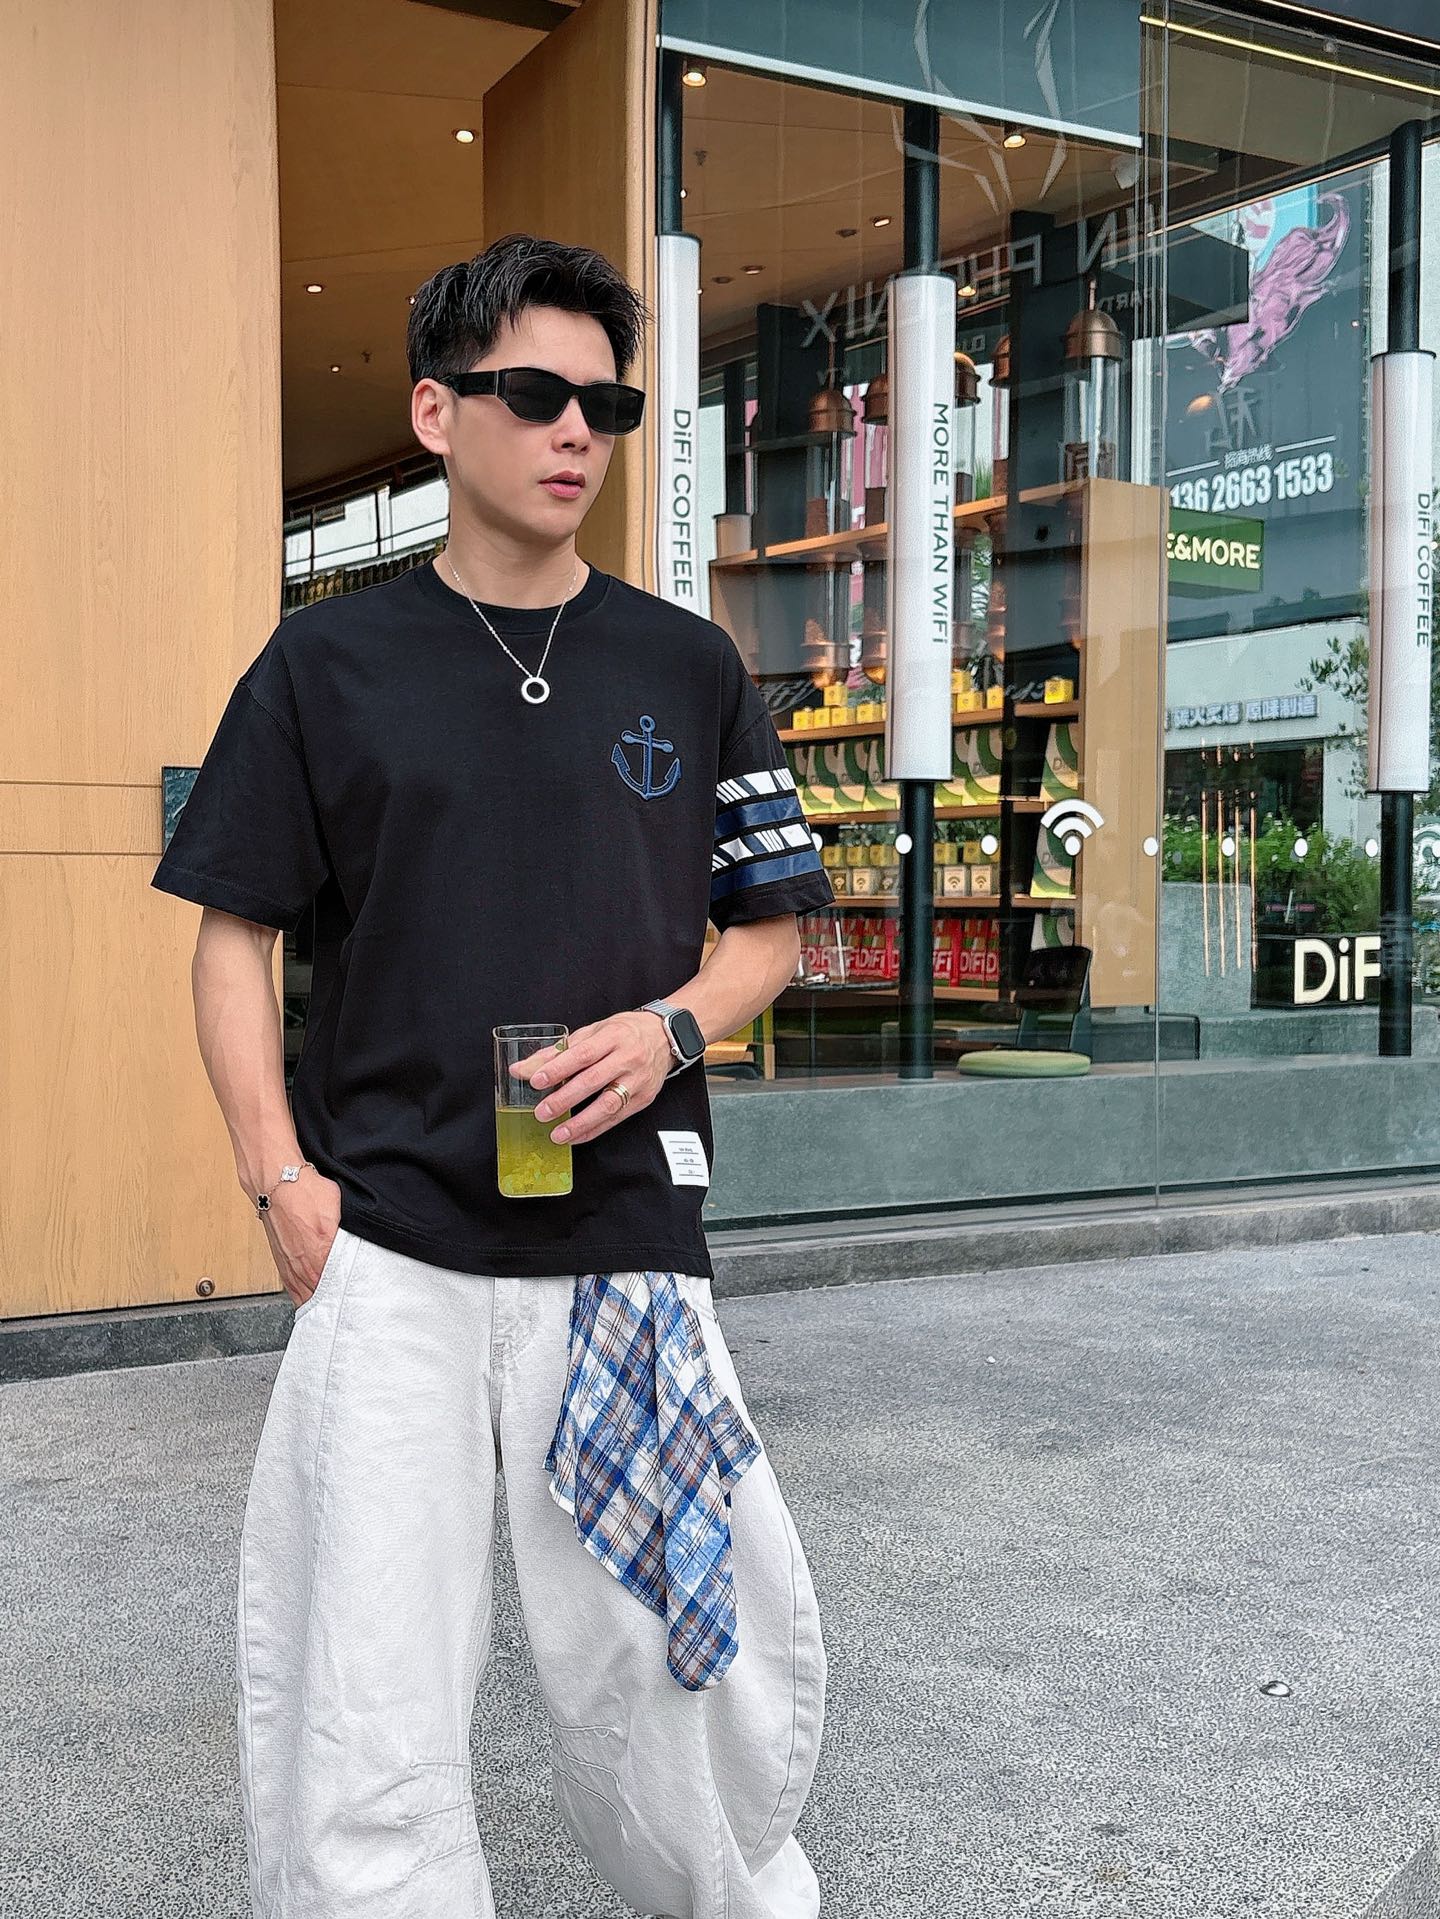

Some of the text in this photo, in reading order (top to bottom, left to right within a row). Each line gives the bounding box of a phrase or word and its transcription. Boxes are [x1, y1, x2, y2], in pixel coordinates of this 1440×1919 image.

[932, 402, 950, 486] MORE
[1211, 464, 1273, 513] 2663
[1273, 451, 1335, 500] 1533
[673, 408, 693, 598] DiFi COFFEE
[932, 495, 949, 573] THAN
[1416, 545, 1431, 648] COFFEE
[1293, 935, 1381, 1005] DiF
